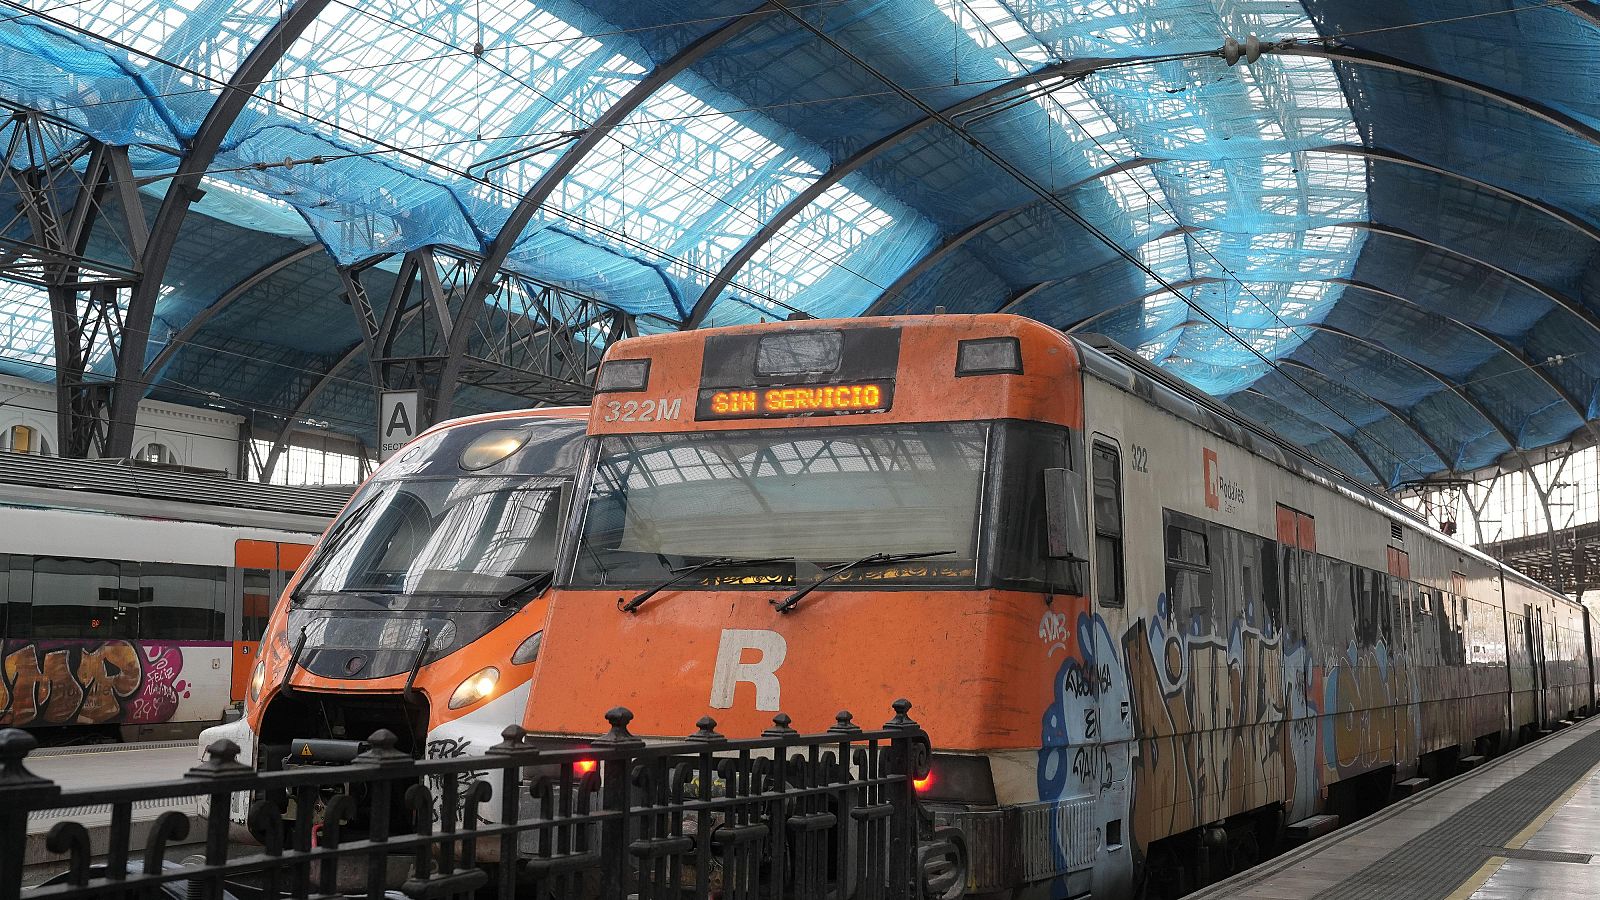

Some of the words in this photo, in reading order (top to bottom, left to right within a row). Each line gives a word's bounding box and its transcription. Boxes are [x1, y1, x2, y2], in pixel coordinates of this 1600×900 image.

[604, 397, 682, 423] 322M
[712, 390, 757, 414] SIN
[764, 384, 881, 412] SERVICIO
[386, 401, 412, 438] A
[1131, 442, 1149, 474] 322
[709, 628, 787, 712] R
